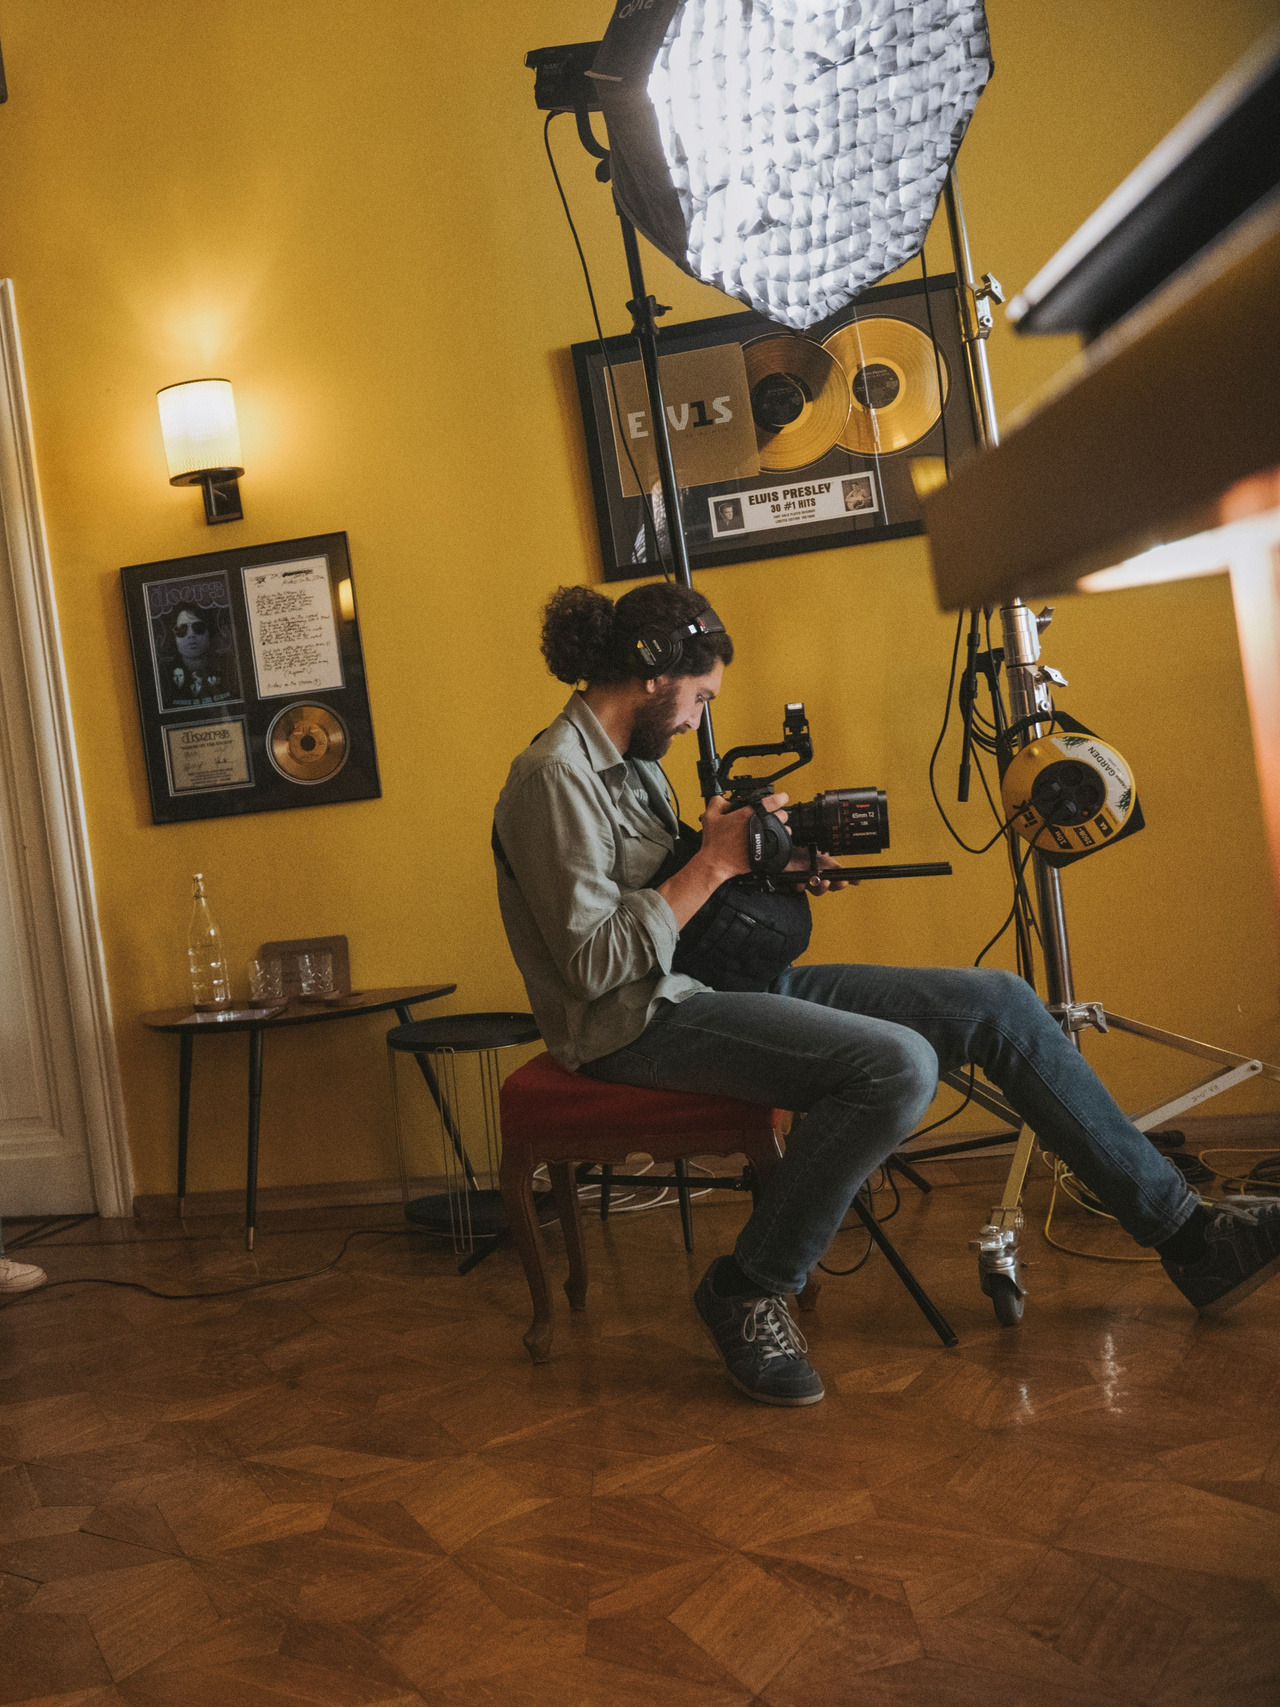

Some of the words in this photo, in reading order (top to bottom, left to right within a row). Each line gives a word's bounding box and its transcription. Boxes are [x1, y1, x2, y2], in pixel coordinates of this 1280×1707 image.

[627, 396, 732, 439] EV1S
[748, 491, 779, 506] ELVIS
[782, 482, 831, 500] PRESLEY
[770, 503, 781, 513] 30
[784, 501, 796, 511] #1
[798, 498, 816, 509] HITS
[1087, 746, 1116, 776] GARDEN
[754, 833, 762, 861] Canon
